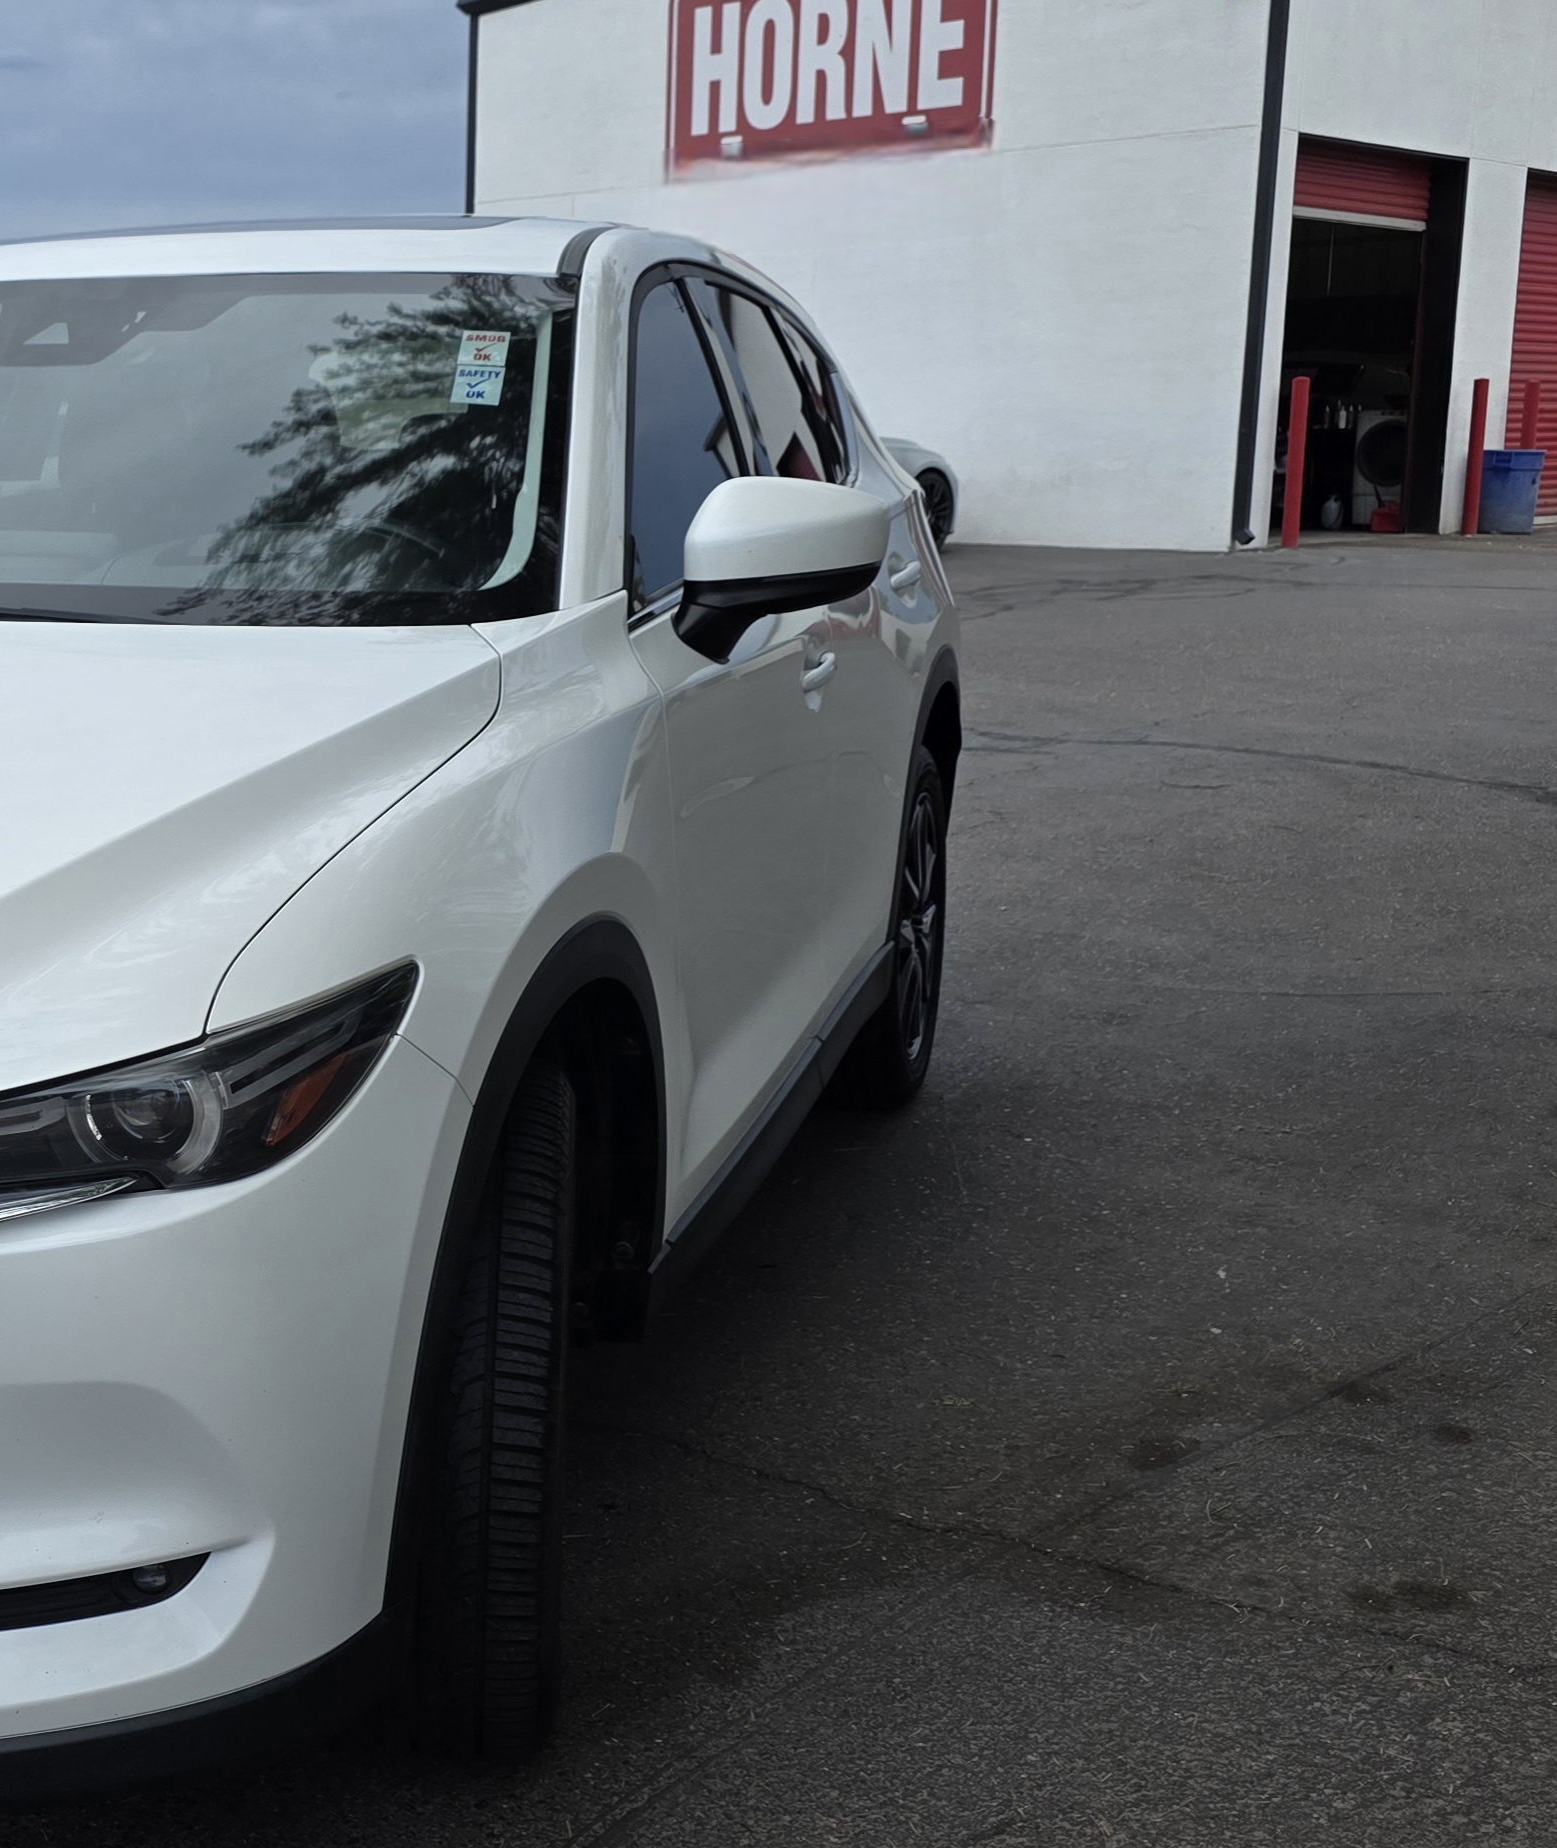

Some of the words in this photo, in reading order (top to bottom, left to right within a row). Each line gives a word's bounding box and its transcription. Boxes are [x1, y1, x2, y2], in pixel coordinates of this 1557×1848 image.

[690, 0, 965, 137] HORNE
[473, 353, 492, 362] OK
[458, 369, 502, 379] SAFETY
[465, 390, 486, 399] OK
